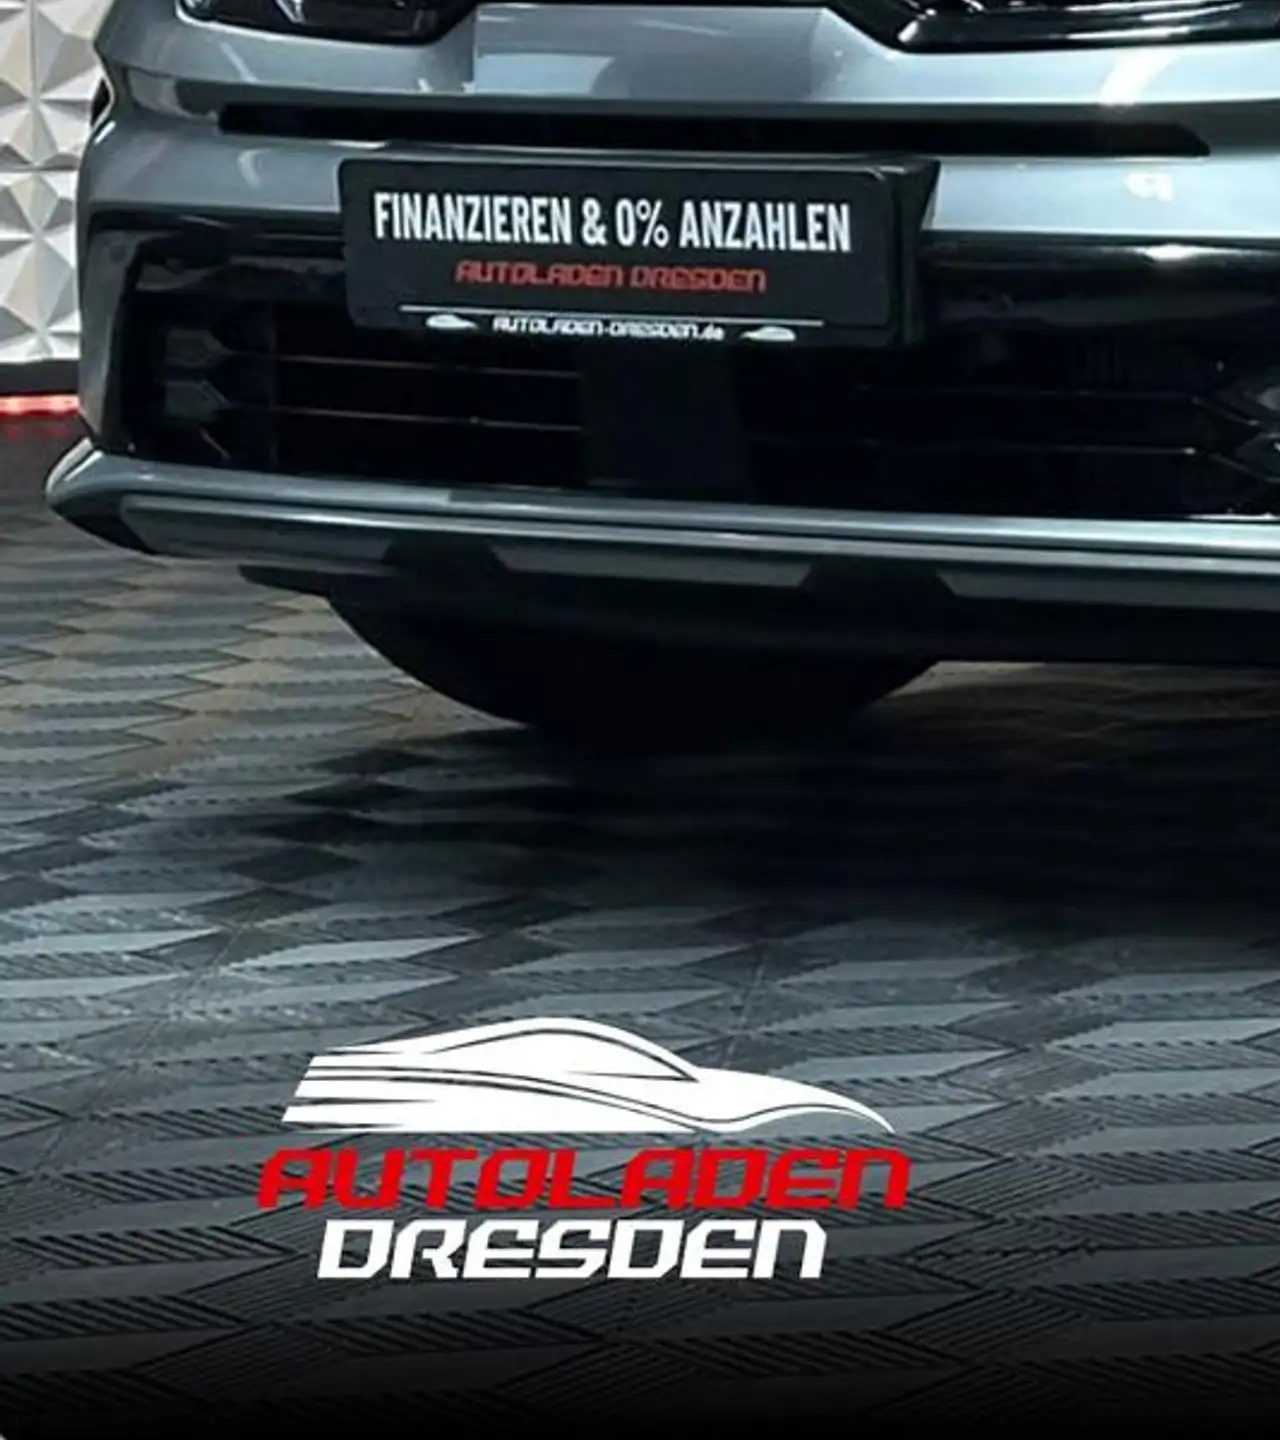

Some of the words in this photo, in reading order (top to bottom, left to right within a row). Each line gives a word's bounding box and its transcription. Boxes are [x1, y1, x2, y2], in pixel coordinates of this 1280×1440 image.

[373, 191, 572, 246] FINANZIEREN
[581, 200, 608, 247] &
[615, 197, 670, 249] 0%
[679, 199, 851, 253] ANZAHLEN
[455, 259, 624, 291] AUTOLADEN
[630, 264, 768, 294] DRESDEN
